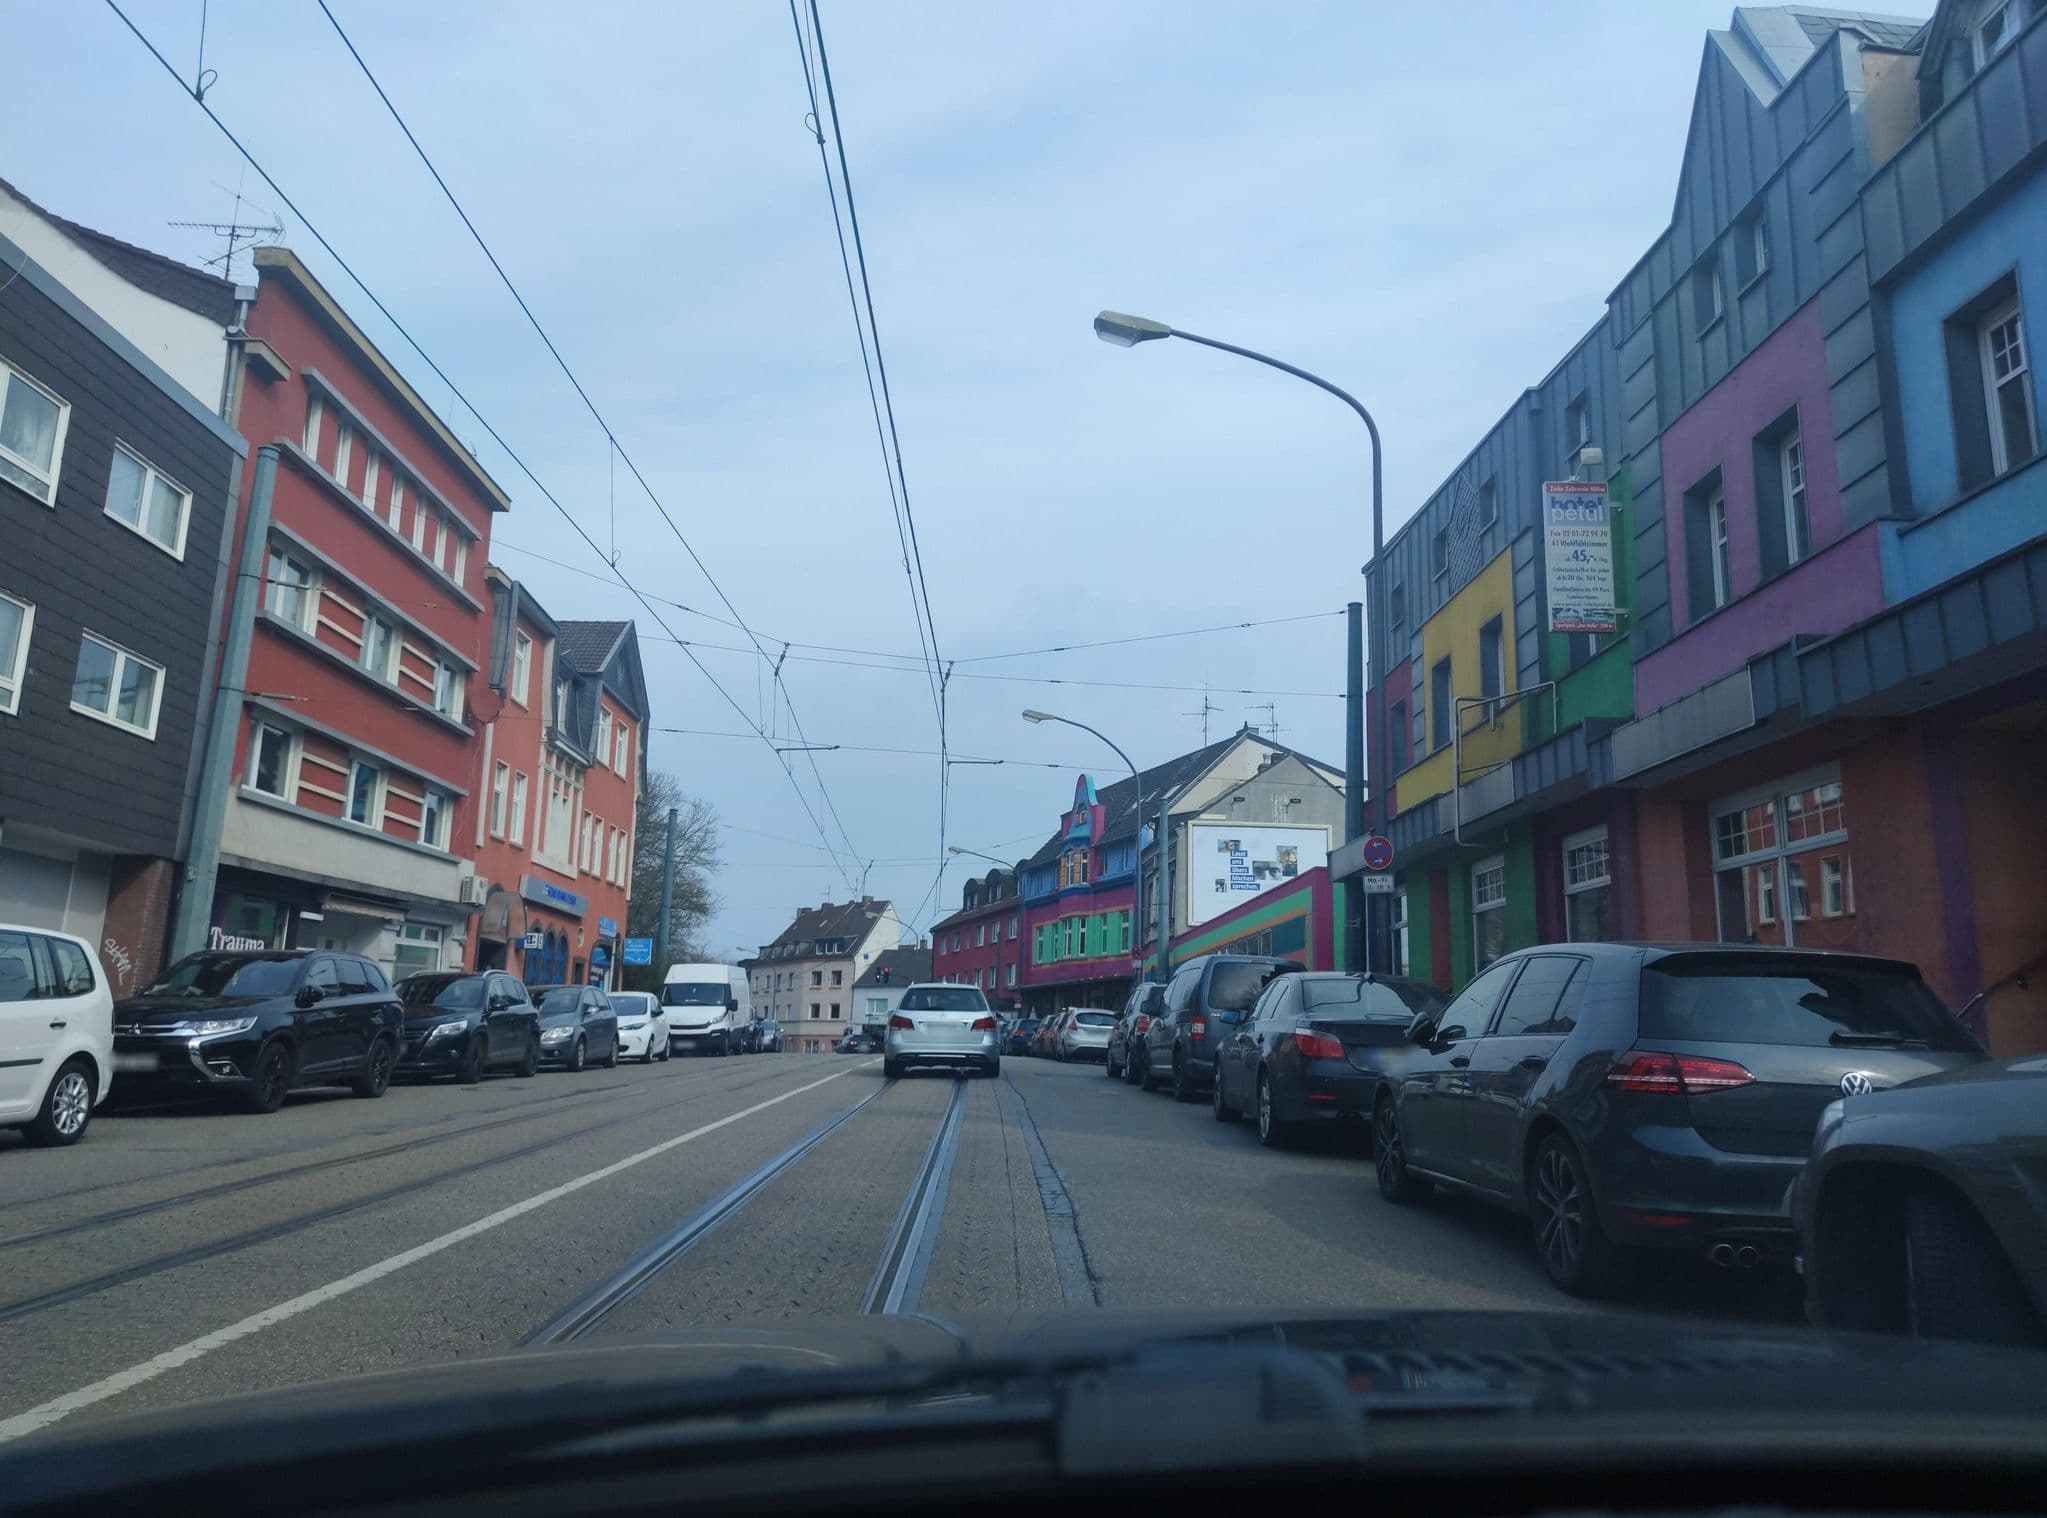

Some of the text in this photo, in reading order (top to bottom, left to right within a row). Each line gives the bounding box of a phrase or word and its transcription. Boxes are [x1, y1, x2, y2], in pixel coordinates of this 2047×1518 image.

[1551, 496, 1603, 511] hotel
[1551, 505, 1604, 524] petul
[210, 925, 265, 951] Trauma
